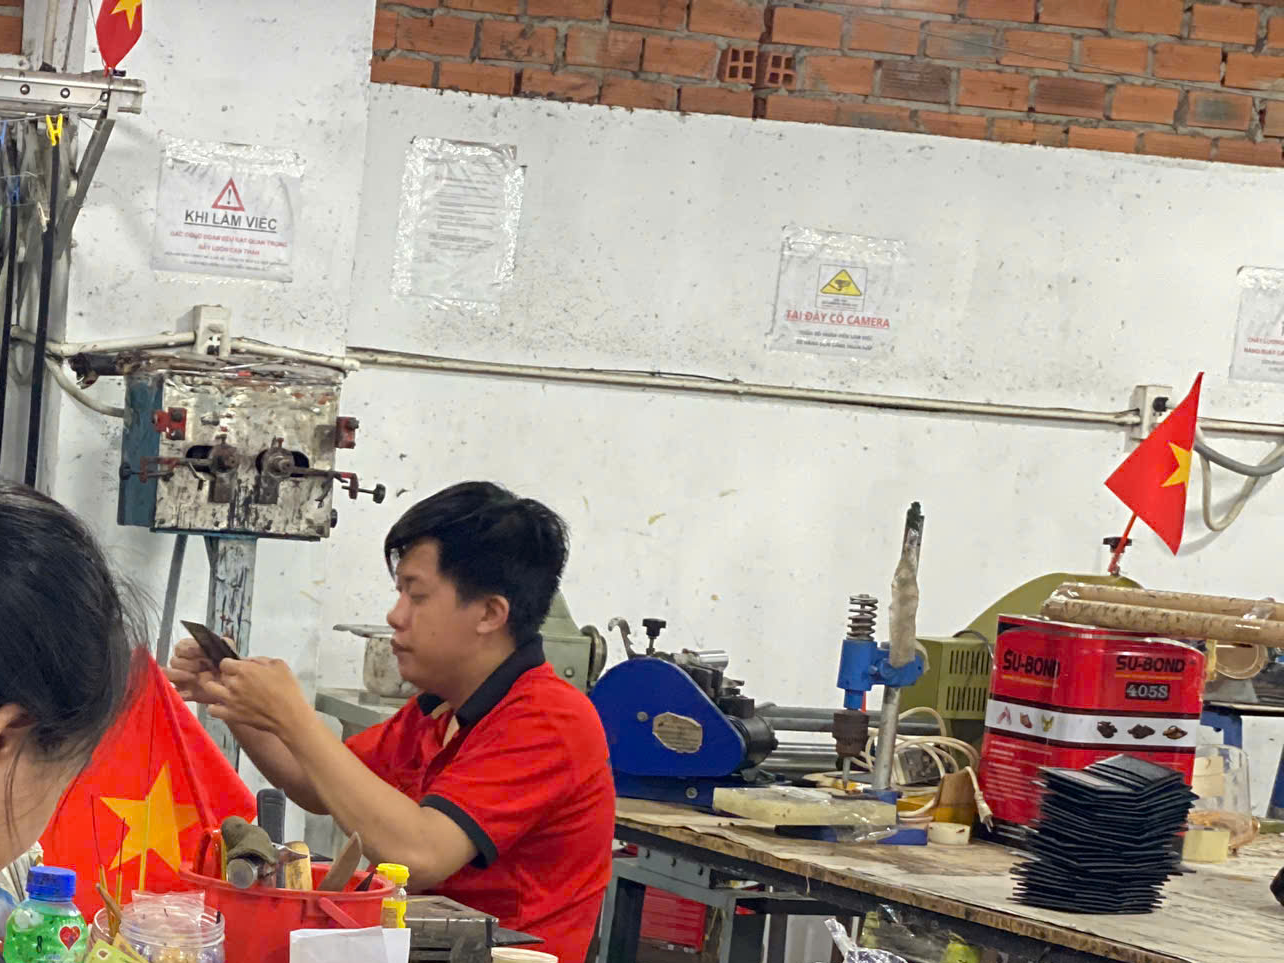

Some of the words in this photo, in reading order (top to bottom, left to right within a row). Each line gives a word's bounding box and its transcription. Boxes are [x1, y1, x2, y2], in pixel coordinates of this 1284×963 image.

[184, 209, 209, 223] KHI
[846, 314, 891, 329] CAMERA
[1002, 649, 1061, 679] SU-BOND
[1116, 654, 1186, 673] SU-BOND
